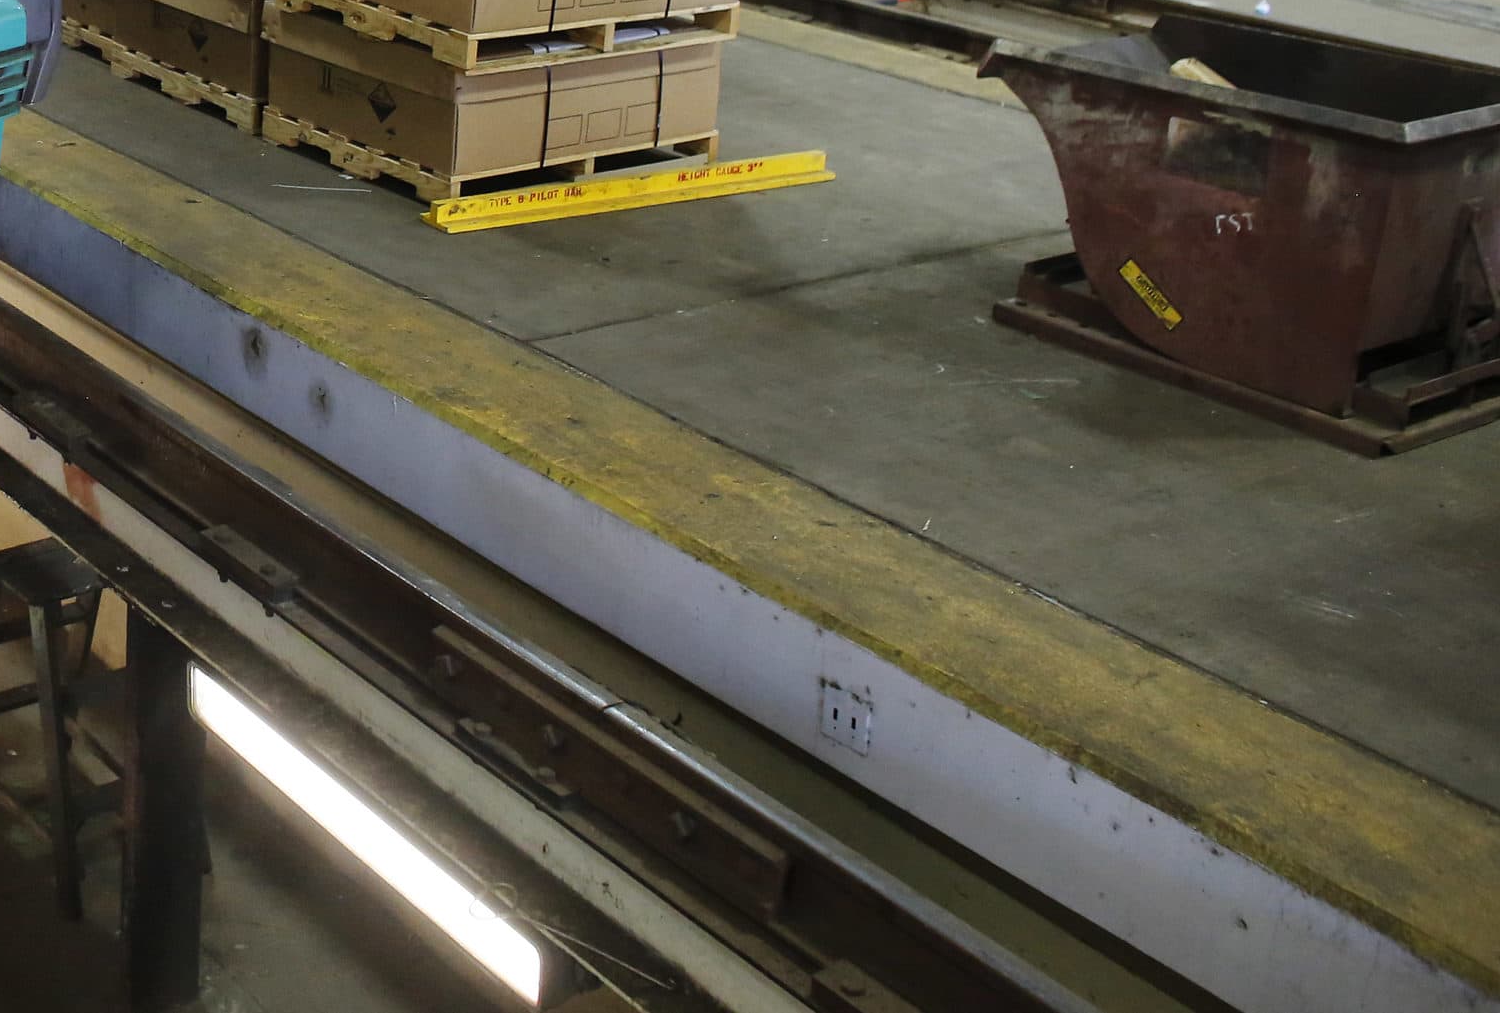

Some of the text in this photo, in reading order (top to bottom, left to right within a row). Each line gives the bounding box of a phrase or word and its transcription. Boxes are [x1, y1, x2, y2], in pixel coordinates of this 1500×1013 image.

[678, 169, 710, 182] HEIGHT
[490, 196, 512, 207] TYPE
[529, 190, 558, 203] PILOT
